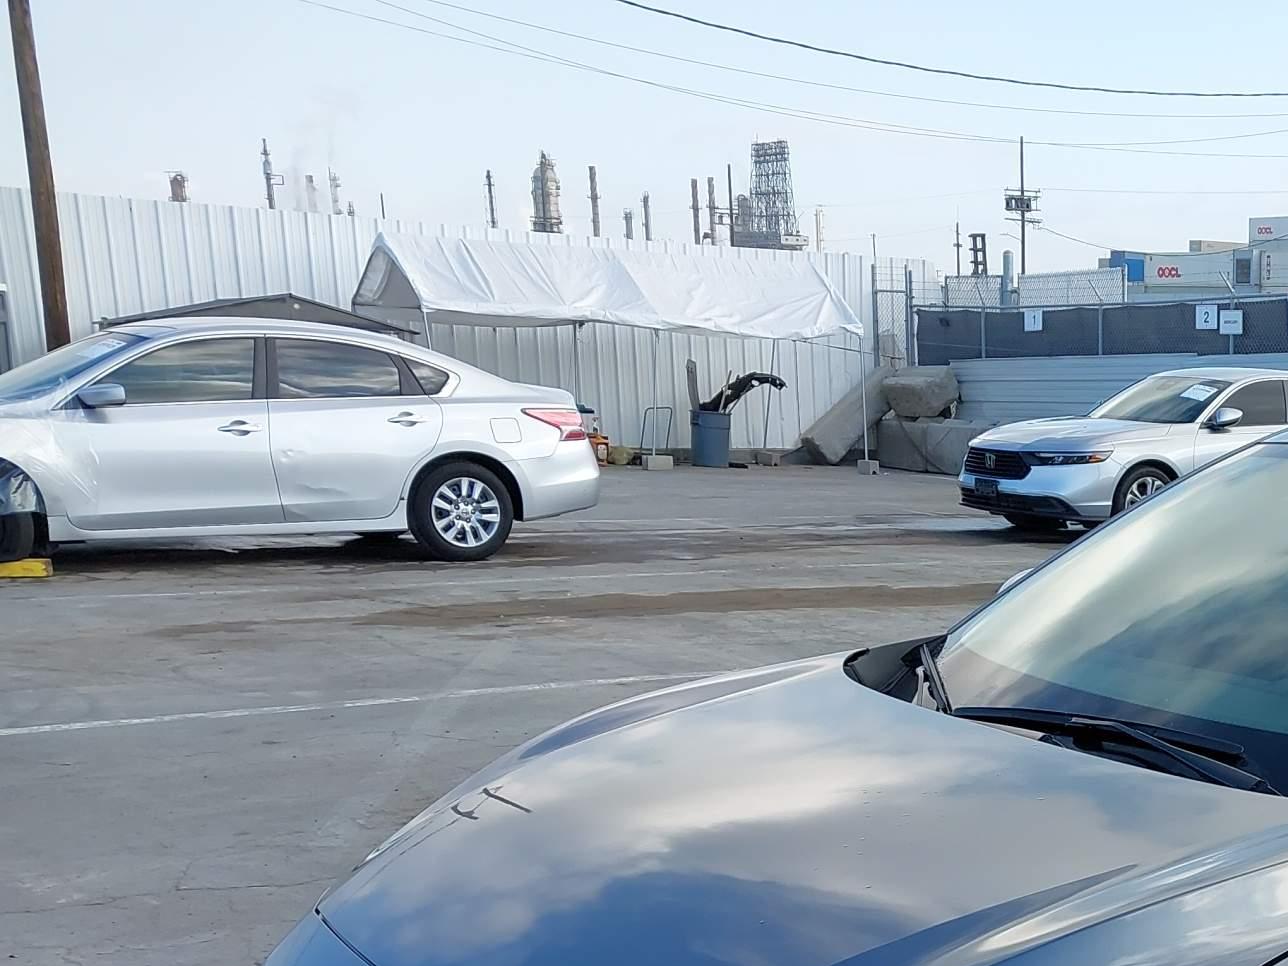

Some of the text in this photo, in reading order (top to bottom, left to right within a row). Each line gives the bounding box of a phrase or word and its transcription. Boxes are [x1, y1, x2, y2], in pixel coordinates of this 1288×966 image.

[1257, 226, 1273, 235] OOCL
[1157, 266, 1182, 278] OOCL
[1203, 311, 1210, 324] 2
